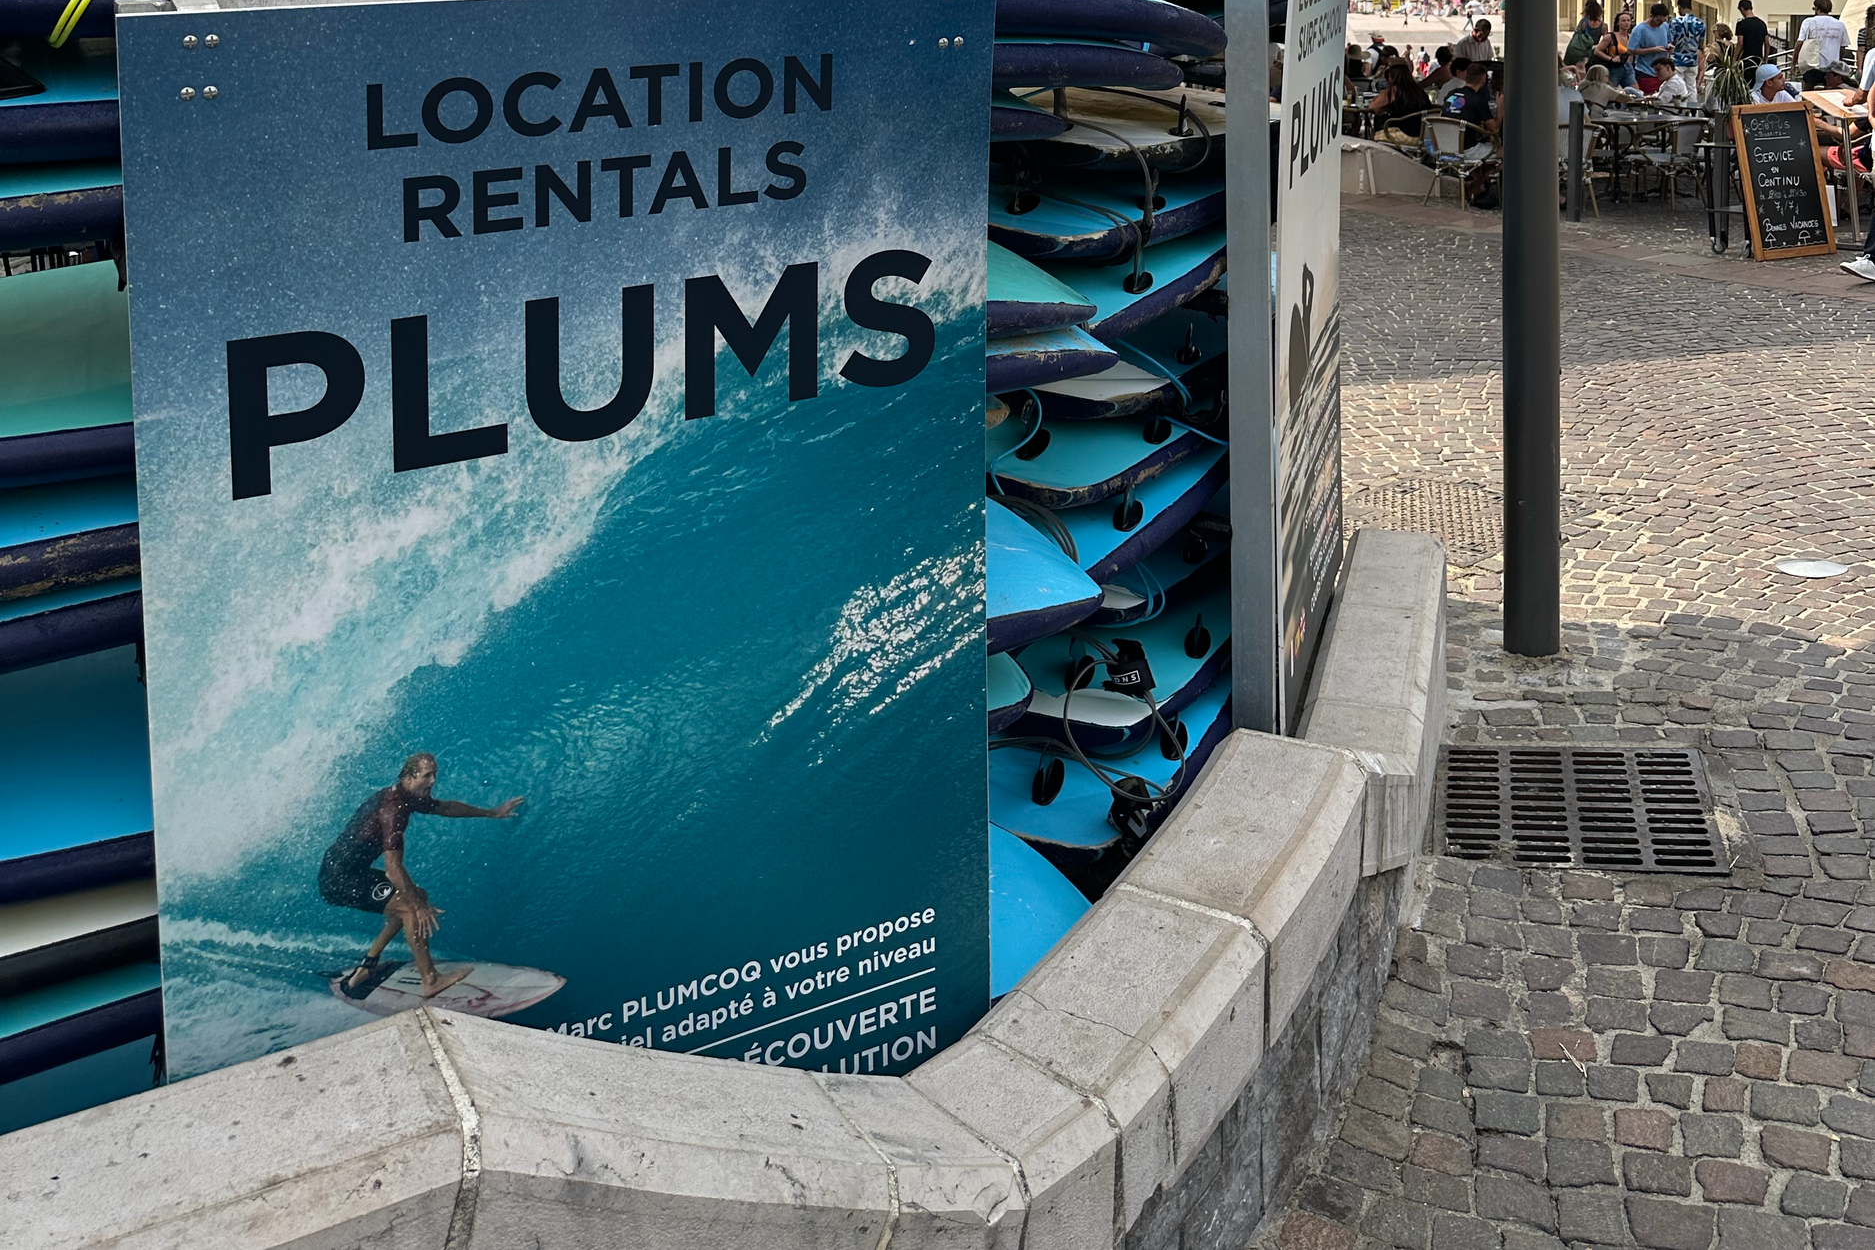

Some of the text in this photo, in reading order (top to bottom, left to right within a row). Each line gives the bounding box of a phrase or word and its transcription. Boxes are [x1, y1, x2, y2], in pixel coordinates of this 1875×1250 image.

[1298, 4, 1342, 62] SURF SCHOOL
[366, 53, 834, 150] LOCATION
[1289, 65, 1341, 190] PLUMS
[402, 141, 808, 244] RENTALS
[1753, 146, 1795, 163] SERVICE
[225, 249, 937, 501] PLUMS
[622, 960, 762, 1023] PLUMCOQ
[769, 940, 829, 974] vous
[836, 907, 936, 955] propose
[661, 992, 754, 1043] adapté
[763, 986, 777, 1007] à
[784, 965, 850, 1000] votre
[857, 937, 937, 977] niveau
[728, 987, 937, 1066] ÉCOUVERTE
